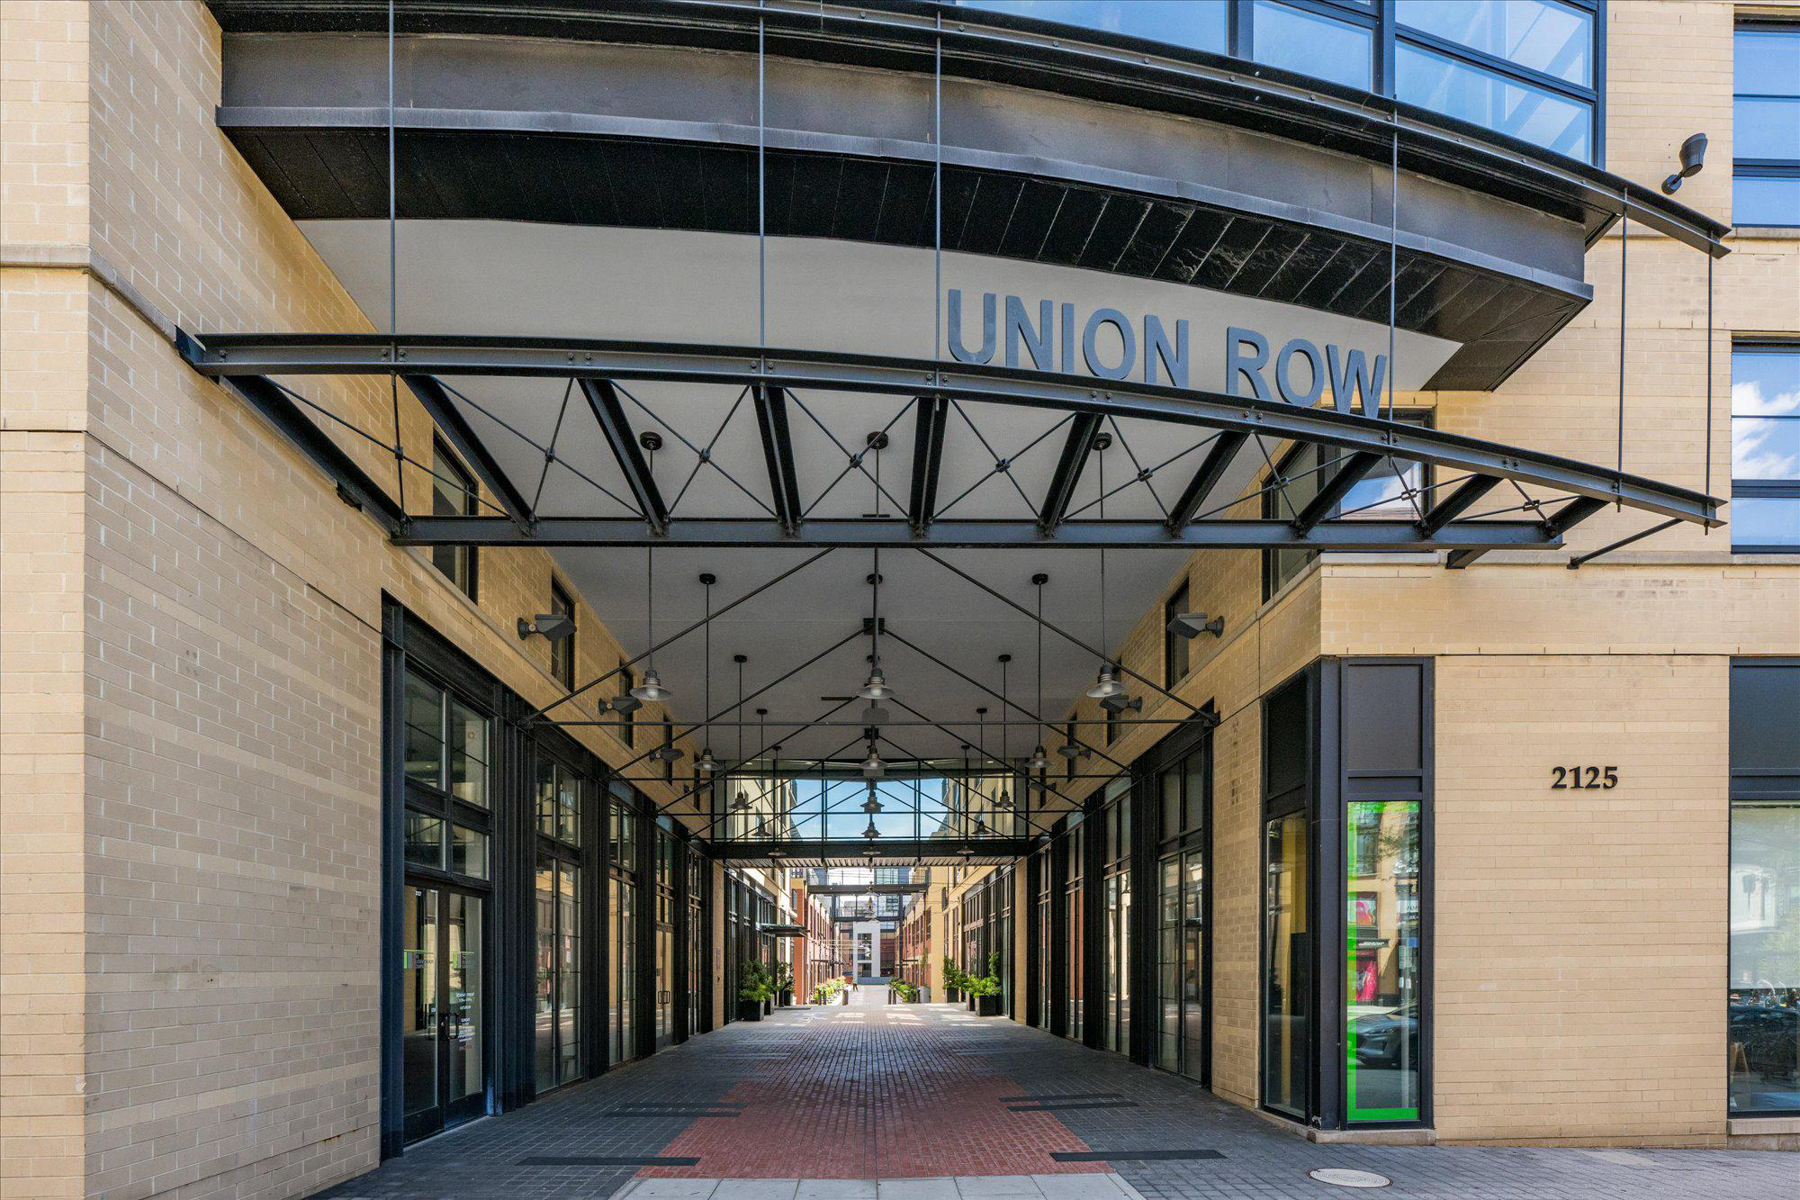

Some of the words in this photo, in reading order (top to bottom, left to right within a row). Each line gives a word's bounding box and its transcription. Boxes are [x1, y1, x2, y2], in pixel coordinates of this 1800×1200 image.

[948, 289, 1189, 388] UNION
[1227, 326, 1387, 418] ROW
[1551, 766, 1618, 789] 2125
